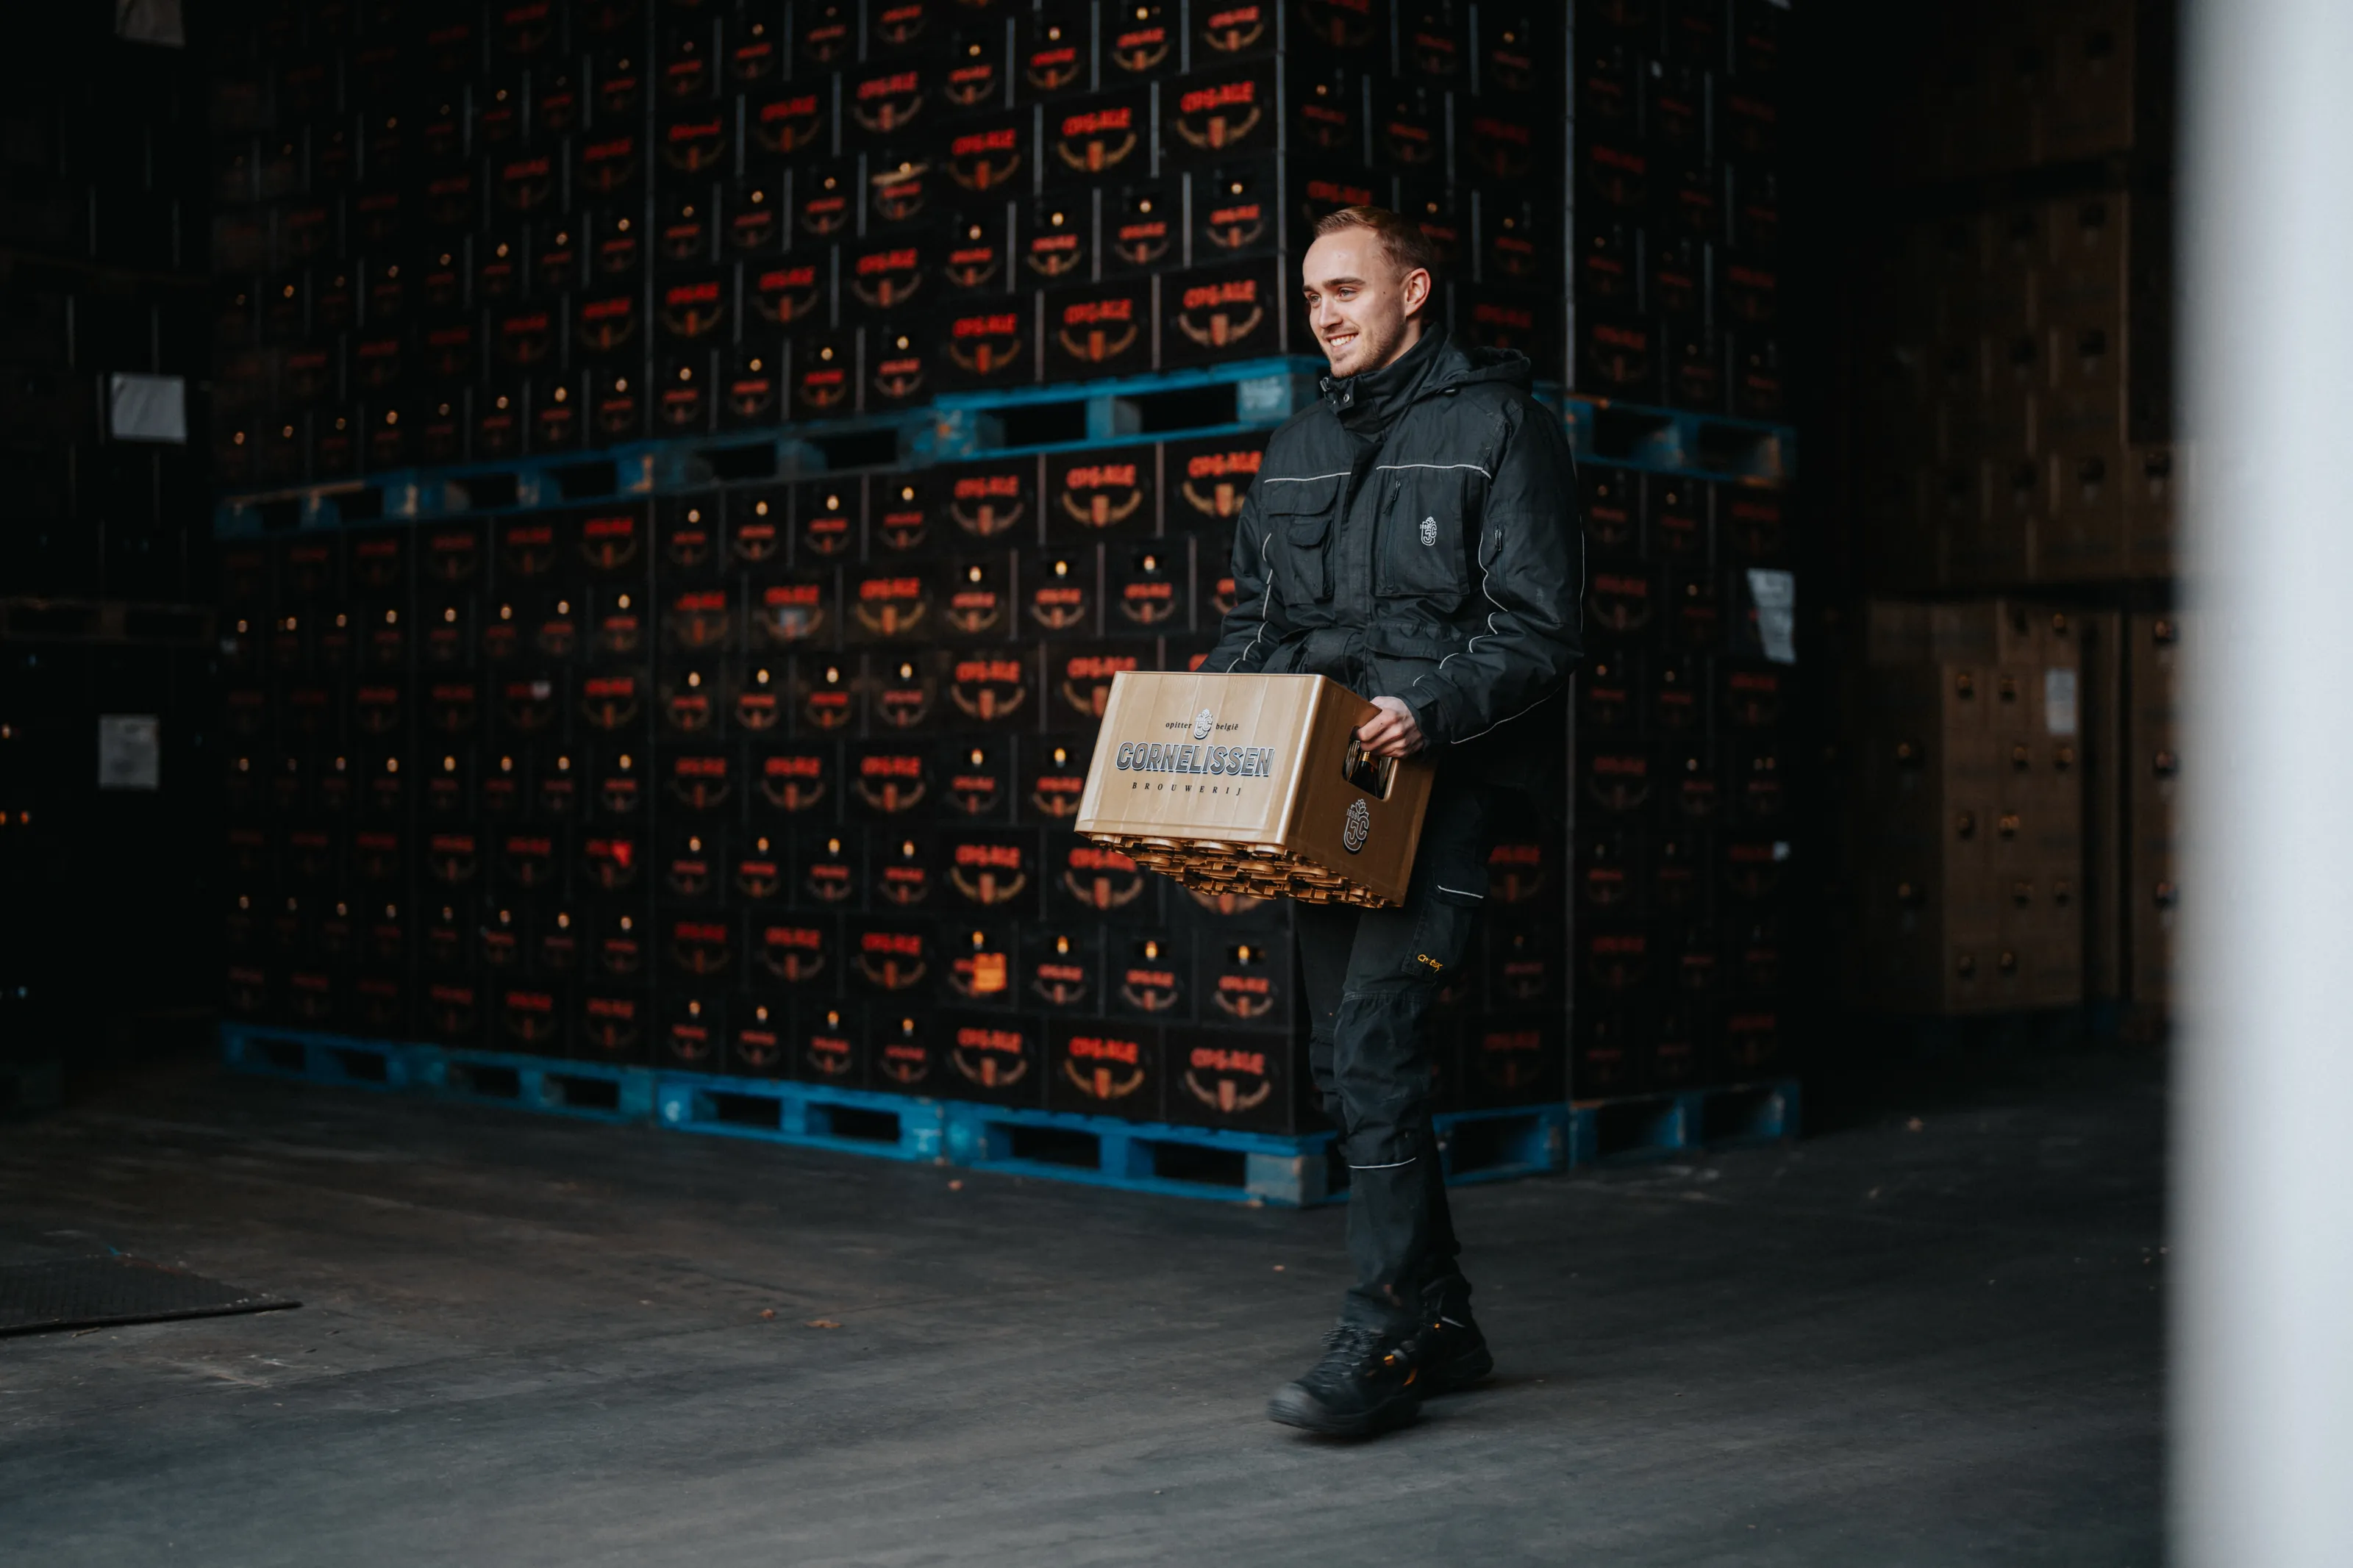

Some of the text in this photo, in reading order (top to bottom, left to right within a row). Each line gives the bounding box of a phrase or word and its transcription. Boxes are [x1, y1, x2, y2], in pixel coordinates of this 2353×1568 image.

[1165, 721, 1239, 732] opitter belgië
[1115, 741, 1275, 777] CORNELISSEN
[1132, 782, 1241, 796] BROUWERIJ
